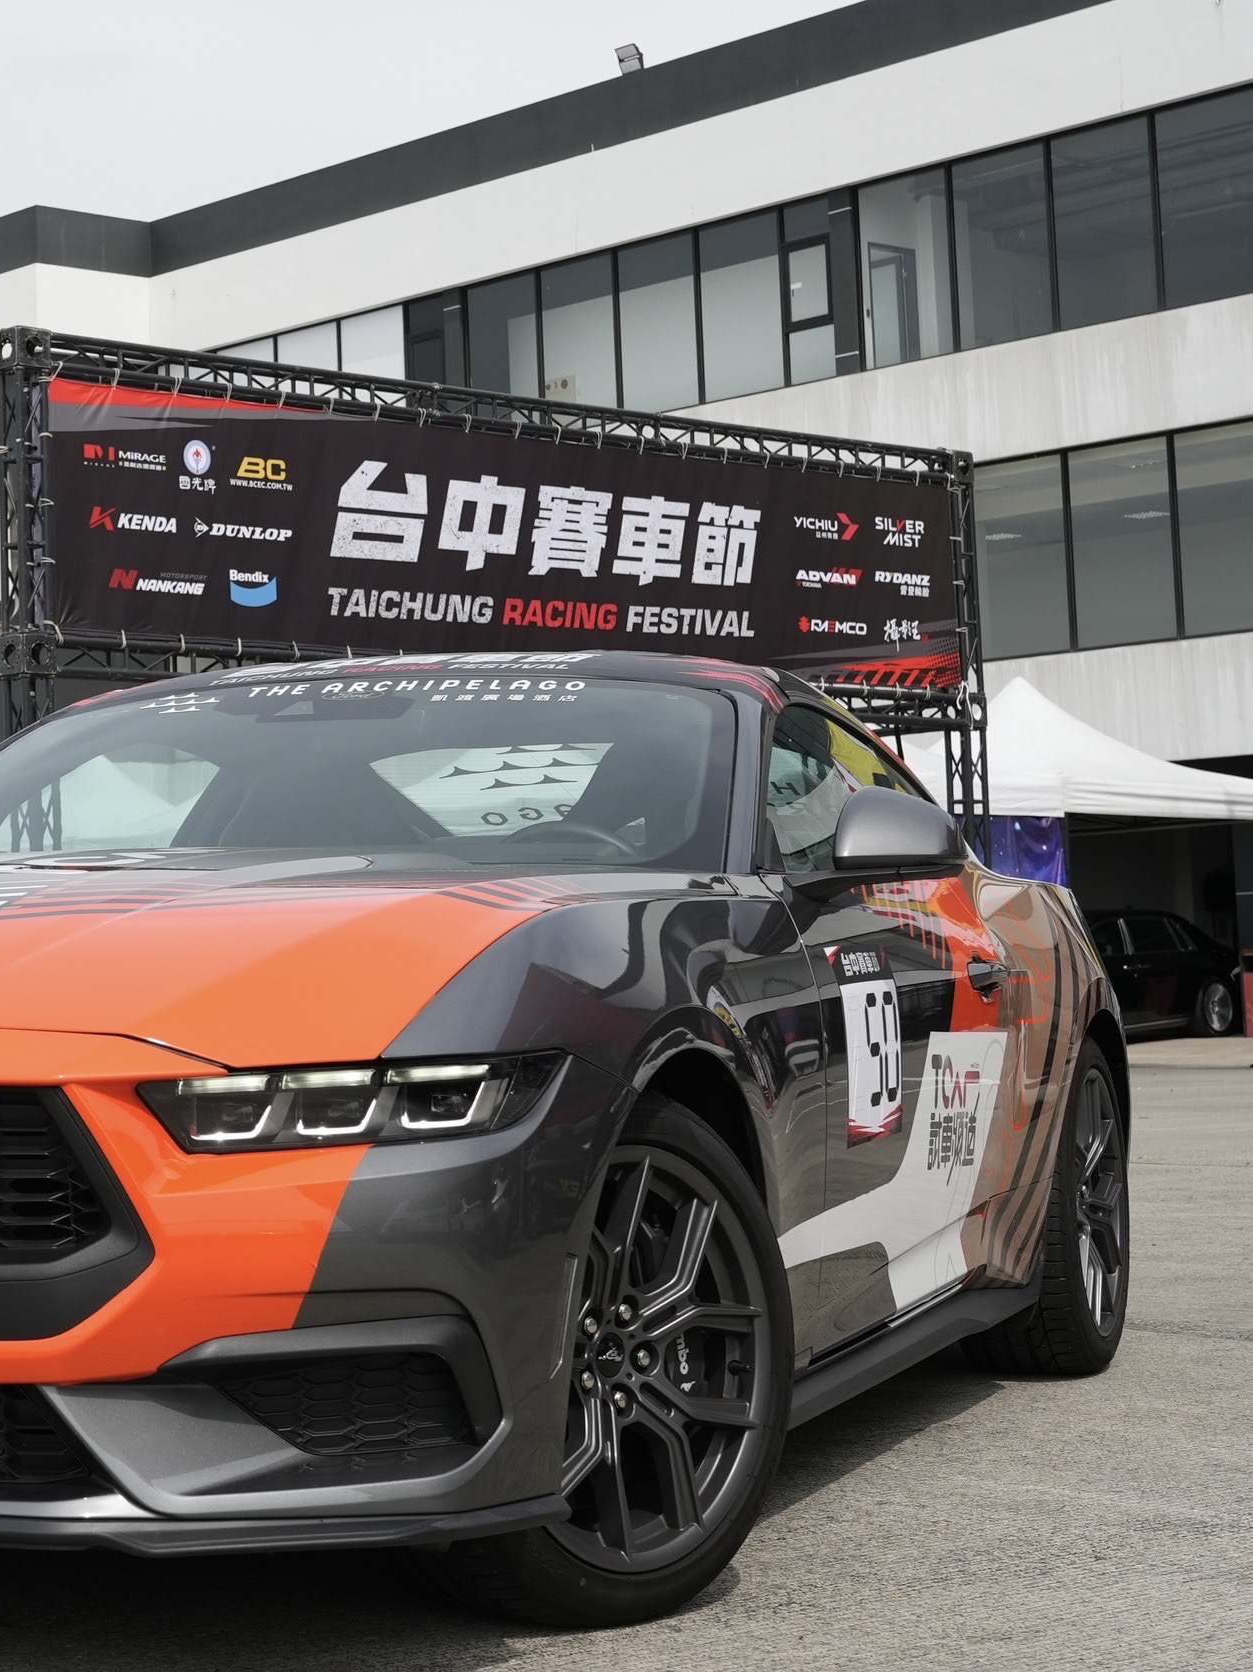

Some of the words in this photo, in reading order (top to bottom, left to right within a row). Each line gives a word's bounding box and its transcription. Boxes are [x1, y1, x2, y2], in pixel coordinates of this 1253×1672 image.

[236, 456, 286, 480] BC
[229, 478, 293, 491] WWW.BCEC.COM.TW
[117, 513, 177, 533] KENDA
[330, 460, 762, 587] 台中賽車節
[794, 516, 838, 531] YICHIU
[875, 516, 925, 534] SILVER
[209, 523, 293, 541] DUNLOP
[883, 532, 921, 548] MIST
[160, 571, 207, 580] MOTORSPORT
[229, 569, 269, 583] Bendix
[796, 569, 856, 585] ADVAN
[874, 571, 930, 586] RYDANZ
[136, 578, 205, 595] NANKANG
[328, 587, 494, 624] TAICHUNG
[502, 598, 618, 631] RACING
[626, 606, 755, 638] FESTIVAL
[248, 684, 310, 698] THE
[321, 679, 586, 694] ARCHIPELAGO
